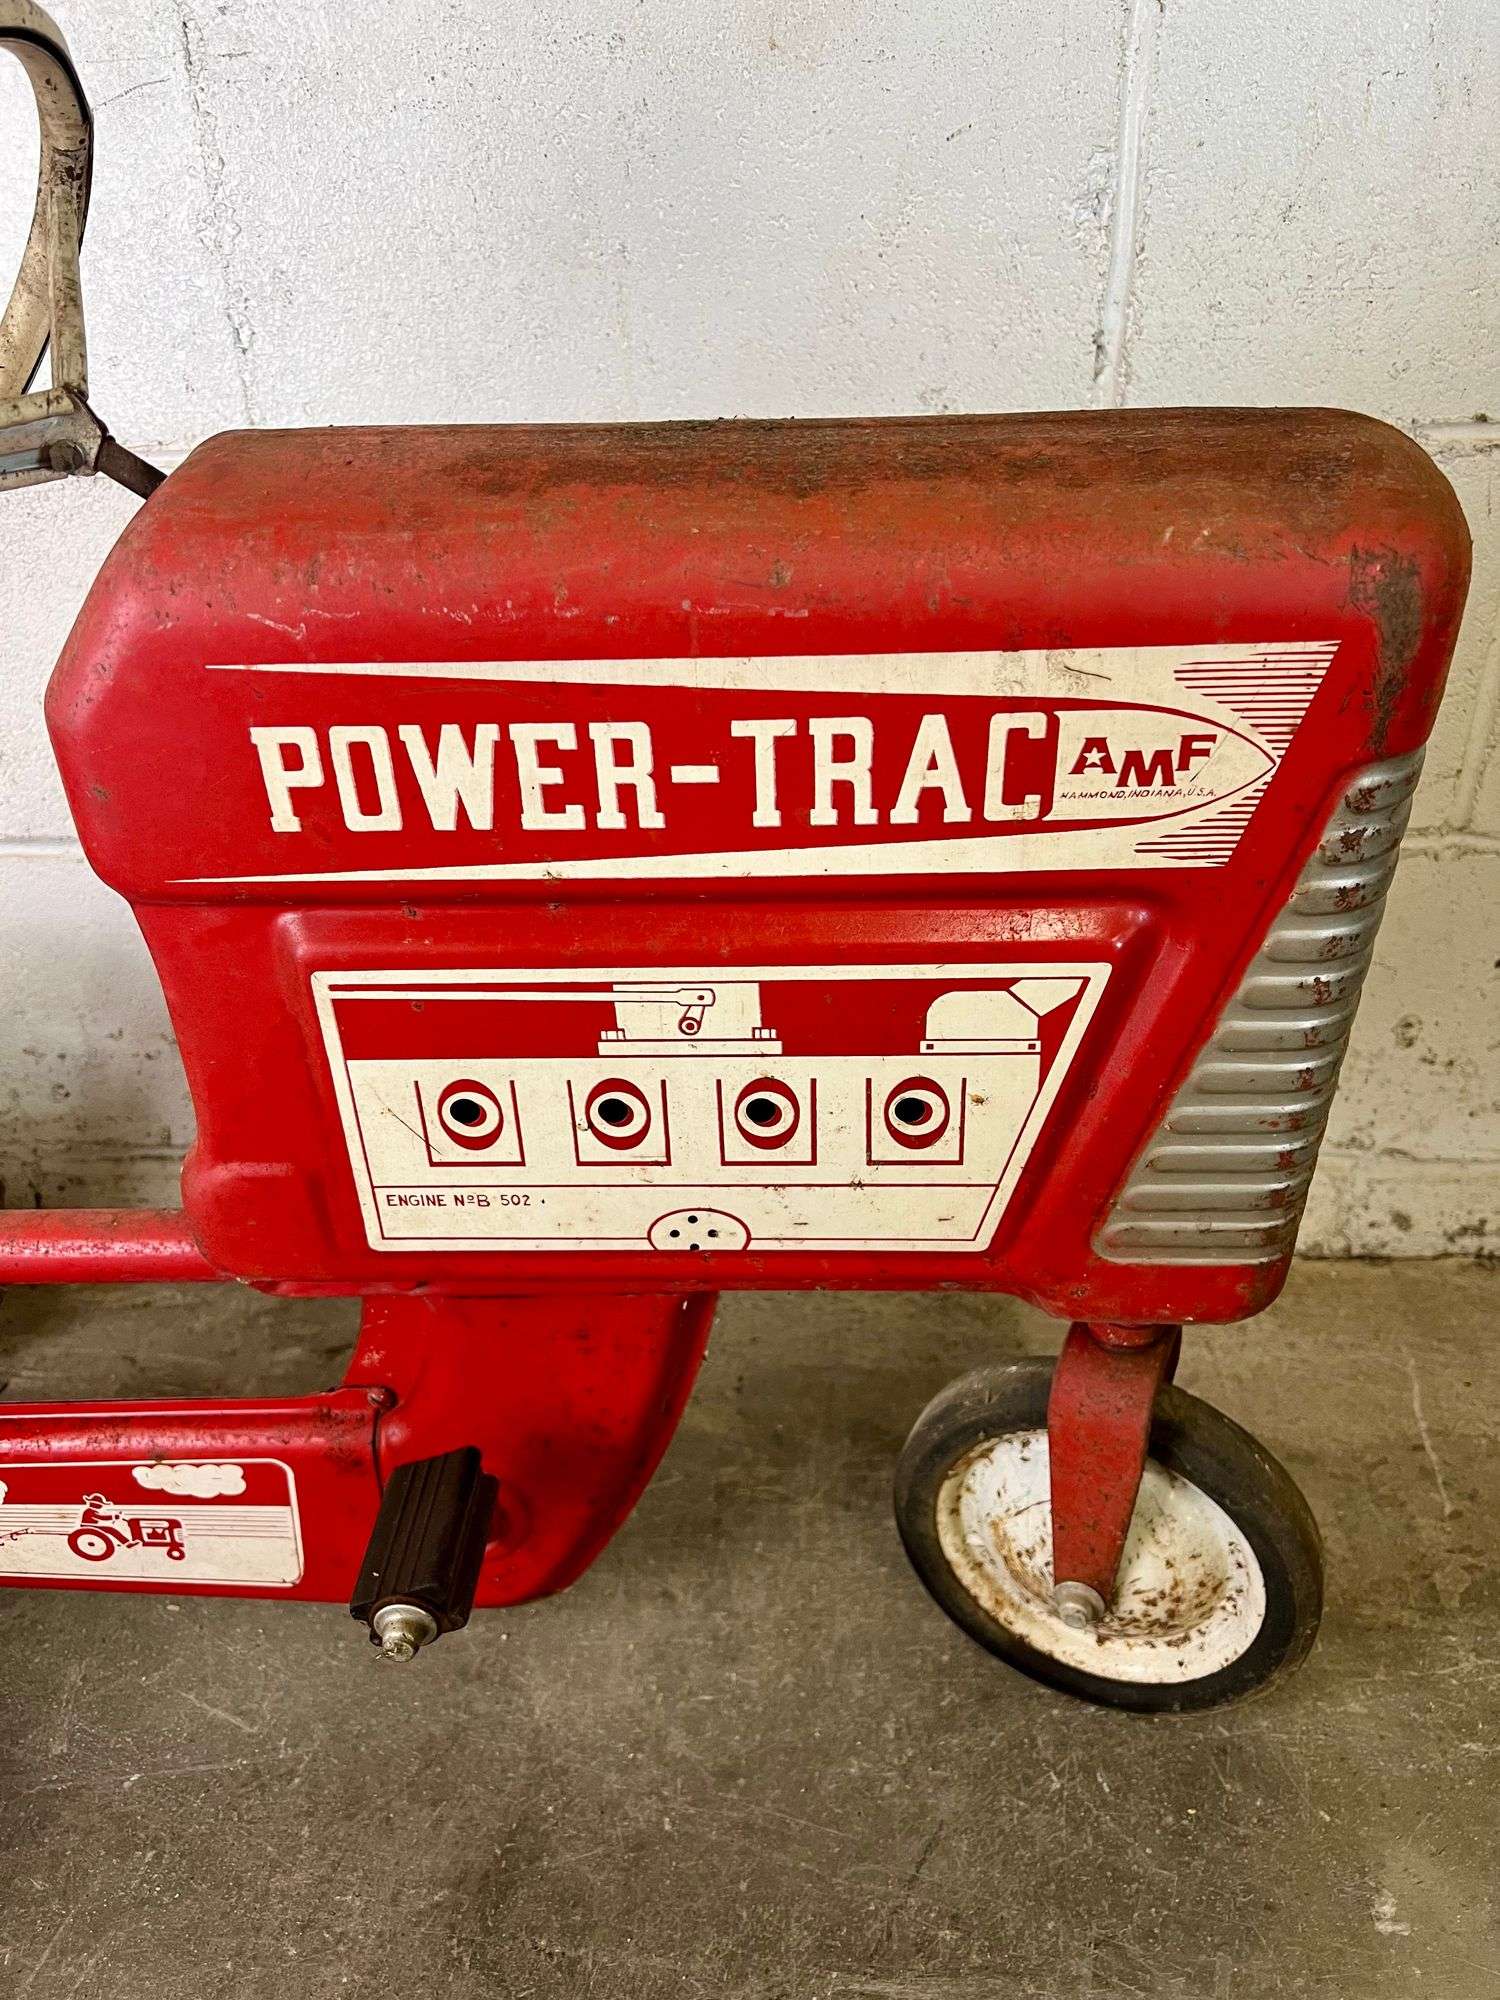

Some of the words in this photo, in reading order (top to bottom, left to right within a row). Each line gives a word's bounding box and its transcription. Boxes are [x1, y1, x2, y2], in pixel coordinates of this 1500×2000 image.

[249, 711, 1048, 832] POWER-TRAC
[1067, 733, 1218, 788] AMF
[385, 1194, 447, 1207] ENGINE
[500, 1194, 531, 1207] 502
